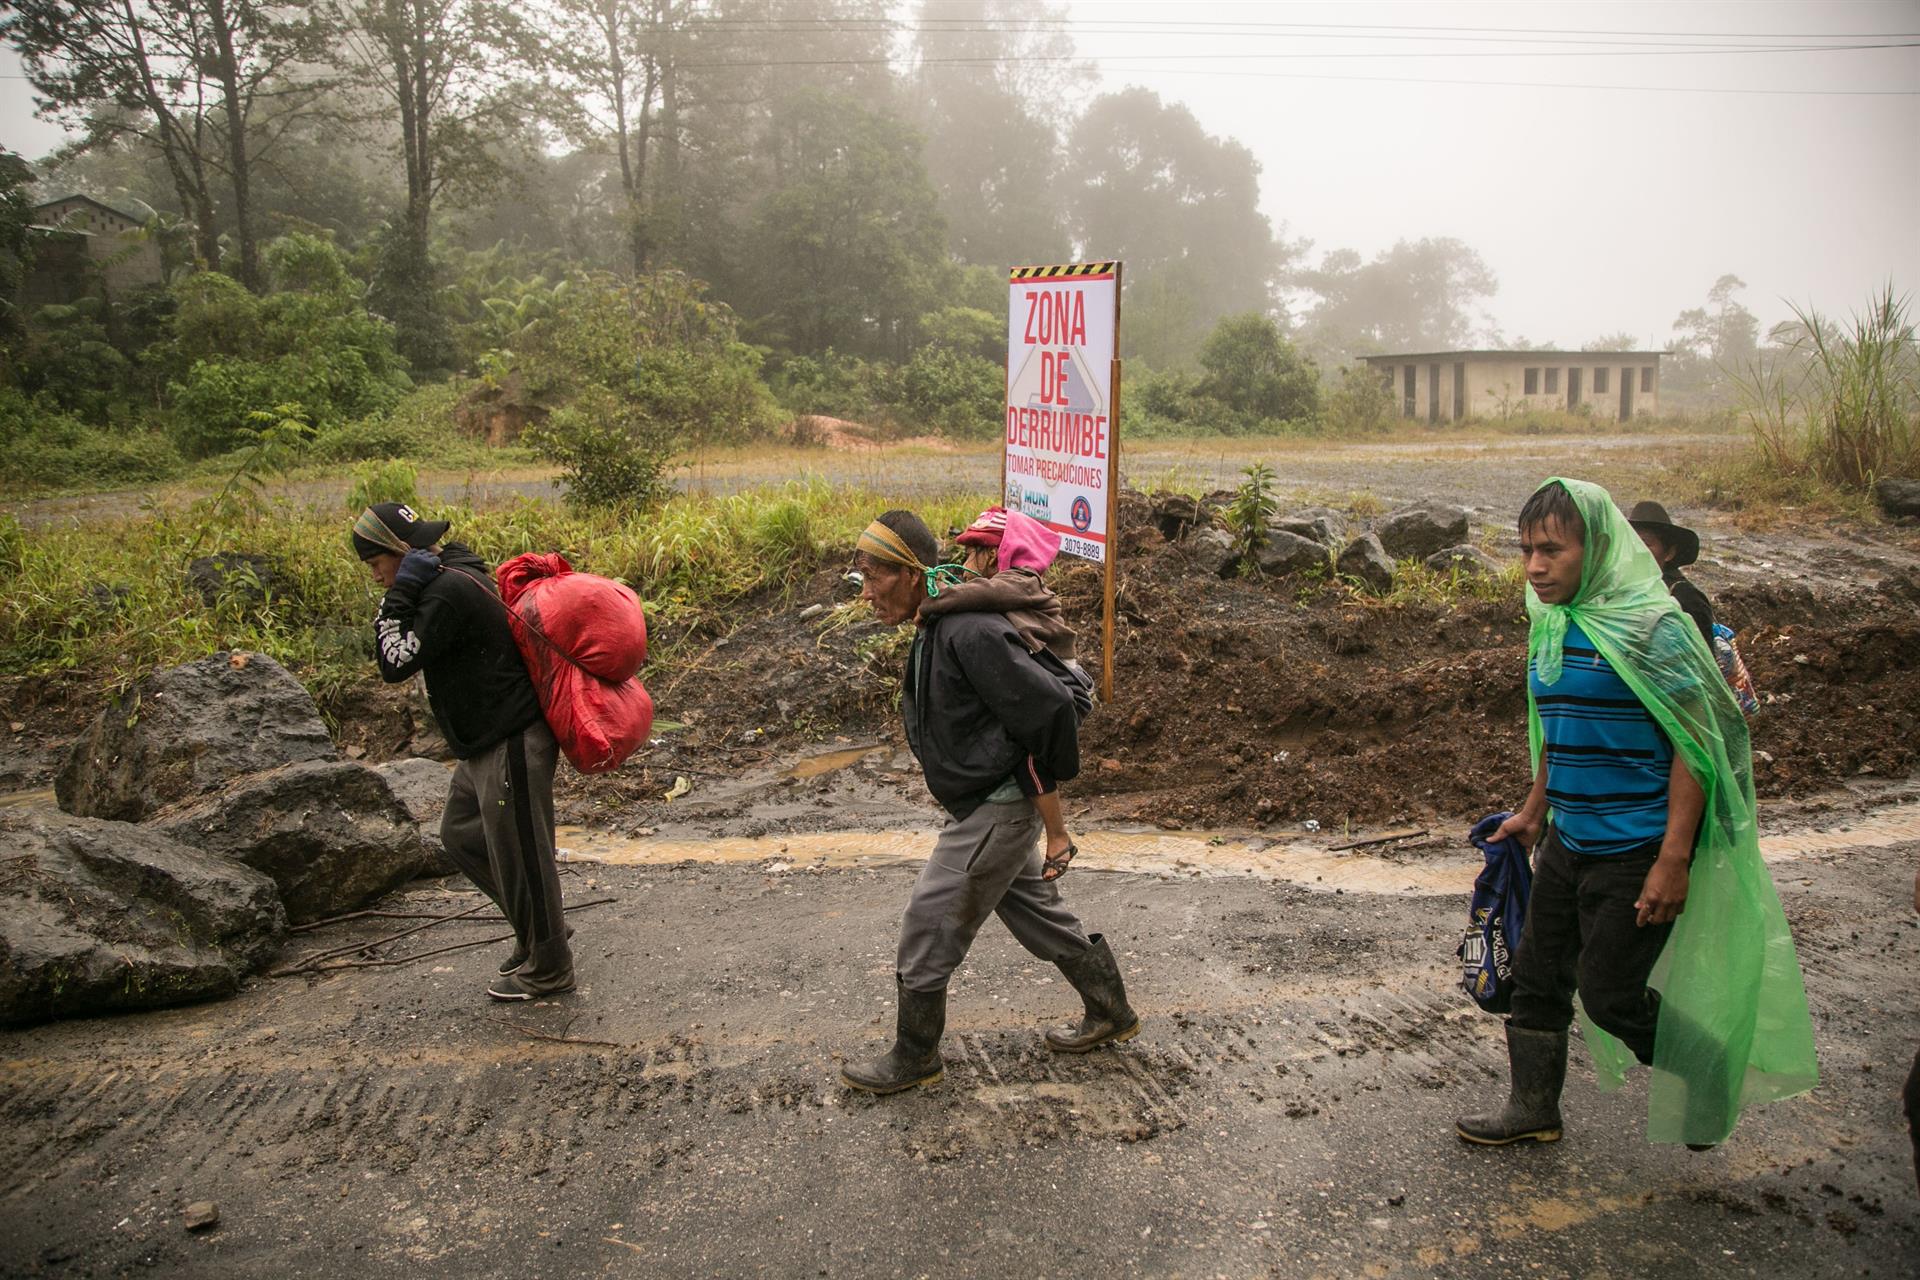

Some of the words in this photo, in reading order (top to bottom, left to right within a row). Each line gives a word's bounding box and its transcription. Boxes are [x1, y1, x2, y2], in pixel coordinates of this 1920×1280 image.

[1024, 290, 1086, 346] ZONA
[1040, 351, 1070, 406] DE
[1007, 405, 1107, 460] DERRUMBE
[1007, 453, 1034, 477] TOMAR
[1035, 459, 1102, 489] PRECAUCIONES
[1024, 490, 1049, 508] MUNI
[1064, 537, 1100, 559] 3079-8889
